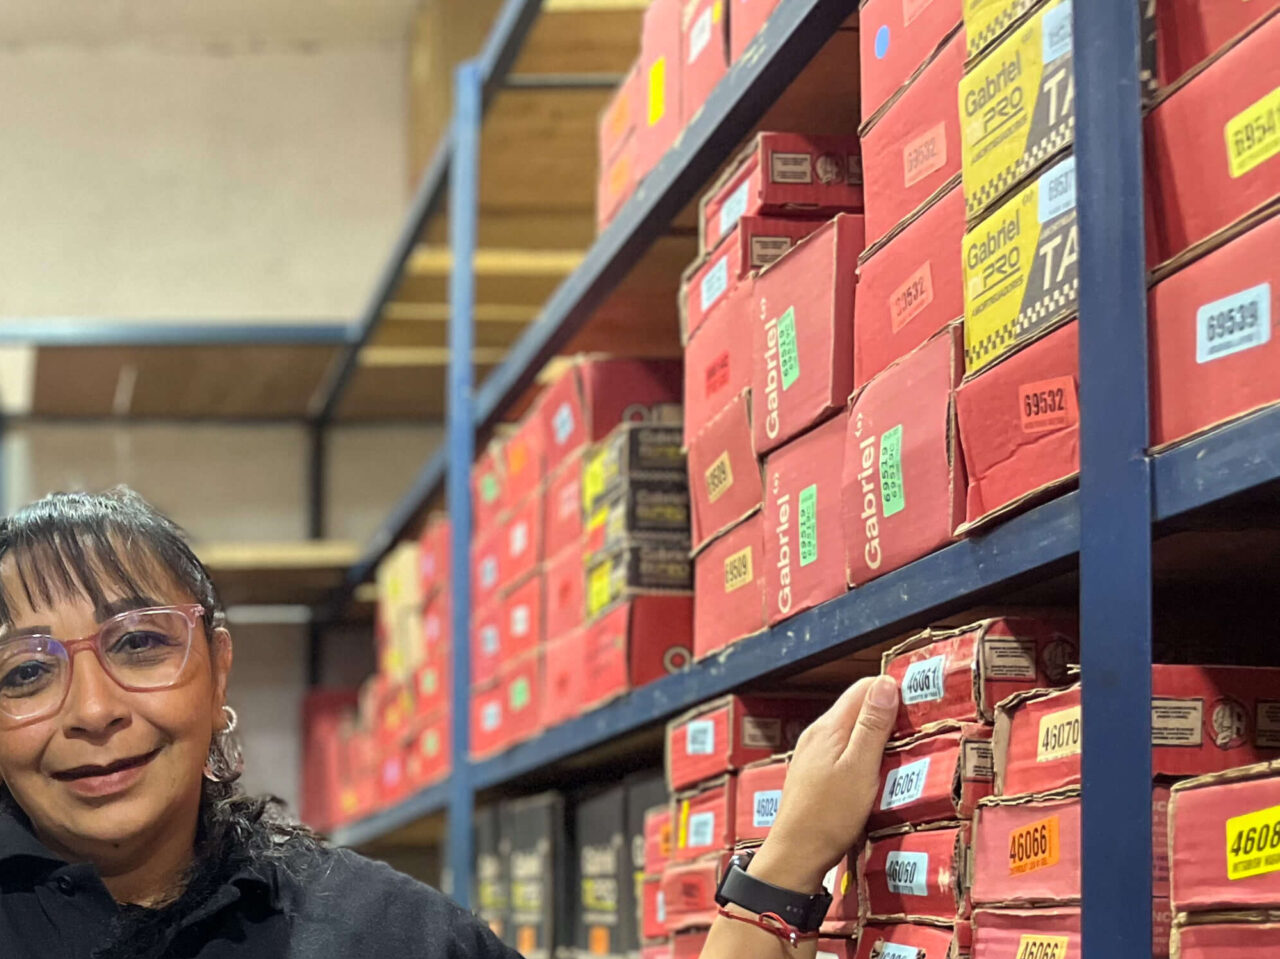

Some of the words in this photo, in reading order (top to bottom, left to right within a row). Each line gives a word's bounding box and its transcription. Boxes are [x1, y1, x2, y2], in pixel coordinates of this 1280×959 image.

[964, 48, 1022, 118] Gabriel
[967, 207, 1021, 271] Gabriel
[982, 246, 1021, 290] PRO
[764, 317, 780, 440] Gabriel
[1024, 387, 1065, 418] 69532
[881, 446, 891, 503] 69519
[858, 435, 882, 570] Gabriel
[776, 493, 792, 614] Gabriel
[906, 666, 937, 695] 46061
[1041, 718, 1080, 751] 46070
[888, 768, 921, 798] 46061
[1009, 823, 1048, 864] 46066
[1231, 820, 1280, 858] 4608
